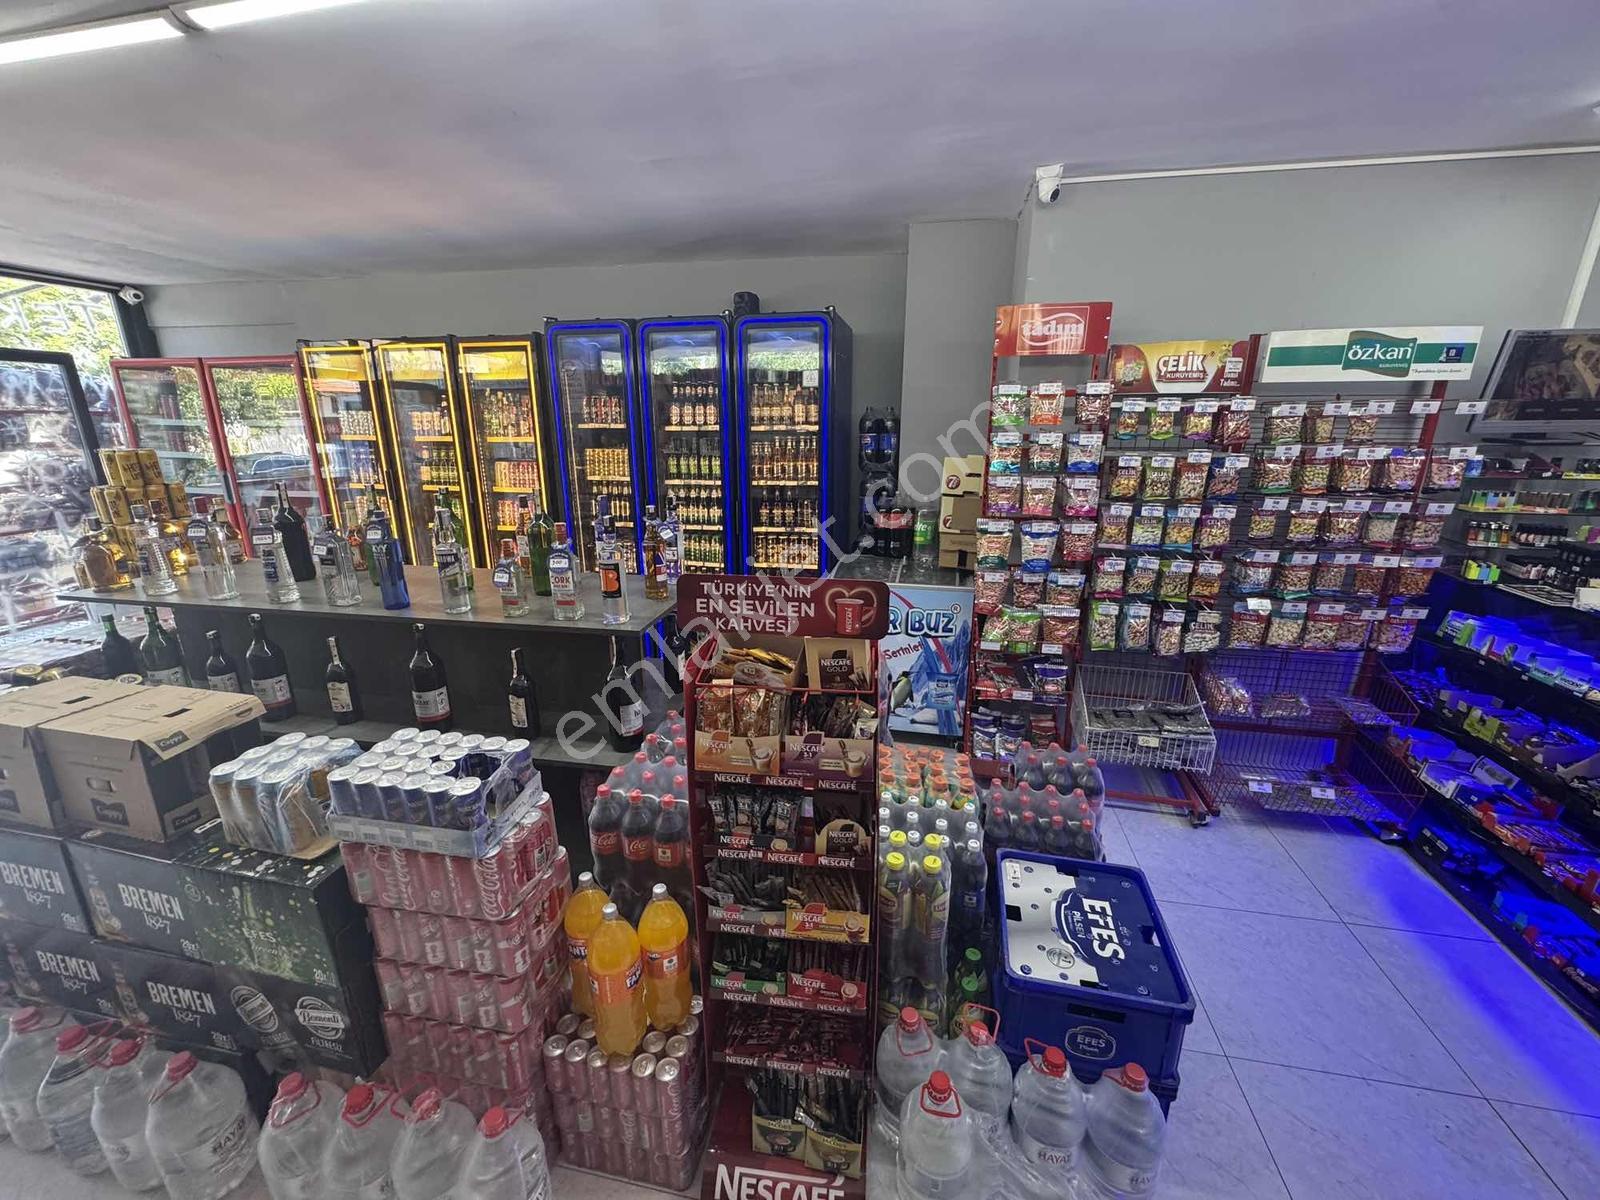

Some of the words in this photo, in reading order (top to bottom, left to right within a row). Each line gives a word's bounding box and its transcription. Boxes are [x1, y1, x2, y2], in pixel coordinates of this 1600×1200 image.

[1347, 344, 1412, 360] özkan
[1157, 352, 1206, 375] ÇELİK
[696, 598, 723, 614] EN
[729, 599, 815, 618] SEVİLEN
[907, 609, 957, 636] BUZ
[714, 773, 751, 784] NESCAFÉ
[765, 776, 804, 787] NESCAFÉ
[818, 779, 857, 791] NESCAFÉ
[818, 855, 856, 868] NESCAFÉ
[0, 861, 65, 895] BREMEN
[118, 883, 185, 921] BREMEN
[720, 923, 755, 935] NESCAFÉ
[1082, 897, 1126, 961] EFES
[35, 950, 101, 983] BREMEN
[146, 980, 217, 1015] BREMEN
[1076, 1033, 1107, 1049] EFES
[713, 1163, 846, 1200] NESCAFÉ
